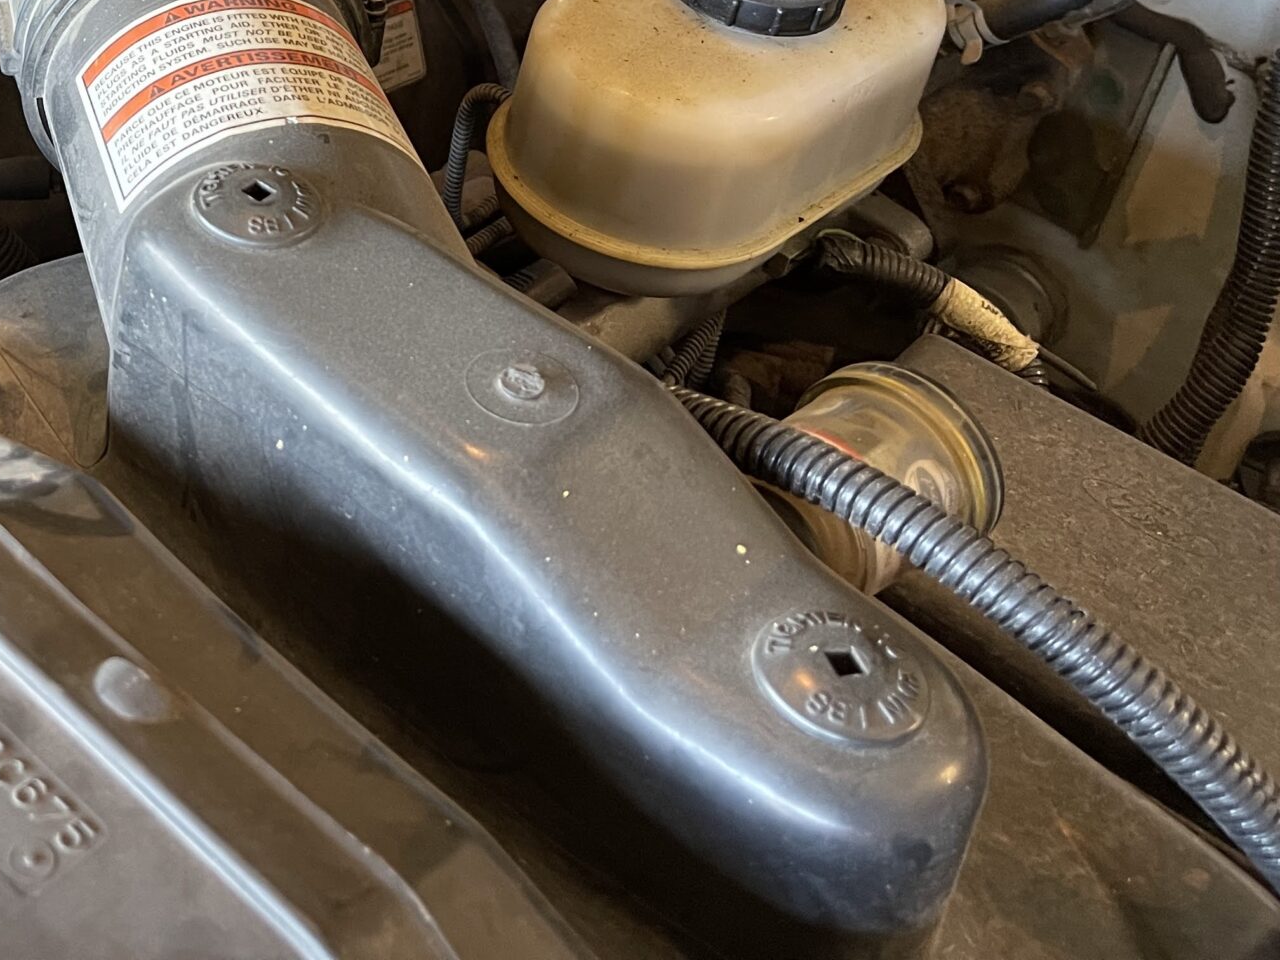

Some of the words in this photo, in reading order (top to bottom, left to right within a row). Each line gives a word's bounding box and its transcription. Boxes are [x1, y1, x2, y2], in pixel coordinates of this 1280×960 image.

[94, 49, 137, 92] BECAUSE
[137, 36, 163, 53] THIS
[164, 17, 212, 39] ENGINE
[212, 14, 224, 24] IS
[227, 13, 268, 22] FITTED
[269, 13, 299, 25] WITH
[97, 69, 128, 100] PLUGS
[131, 55, 146, 69] AS
[150, 48, 160, 57] A
[163, 24, 224, 48] STARTING
[262, 21, 300, 30] ETHER
[305, 27, 321, 37] OR
[100, 63, 147, 109] STARTING
[152, 41, 195, 65] FLUIDS
[202, 31, 238, 44] MUST
[246, 29, 272, 37] NOT
[278, 29, 293, 37] BE
[298, 31, 328, 47] USED
[103, 69, 157, 117] INDUCTION
[159, 46, 211, 71] SYSTEM.
[217, 38, 252, 49] SUCH
[282, 38, 309, 48] MAY
[170, 51, 359, 86] AVERTISSEMENT
[211, 80, 249, 96] POUR
[258, 74, 321, 86] FACILITER
[327, 81, 341, 90] LE
[114, 115, 146, 148] PARCE
[147, 98, 173, 117] QUE
[174, 88, 191, 100] CE
[193, 70, 250, 92] MOTEUR
[253, 67, 278, 76] EST
[120, 153, 129, 166] IL
[131, 139, 147, 155] NE
[148, 115, 178, 140] FAUT
[181, 102, 205, 119] PAS
[209, 87, 267, 106] UTILISER
[270, 84, 324, 96] D'ÉTHER
[327, 89, 341, 98] NI
[123, 143, 160, 175] FLUIDE
[162, 127, 179, 141] DE
[183, 96, 267, 129] DÉMARRAGE
[273, 93, 311, 104] DANS
[127, 158, 153, 184] CELA
[155, 140, 177, 158] EST
